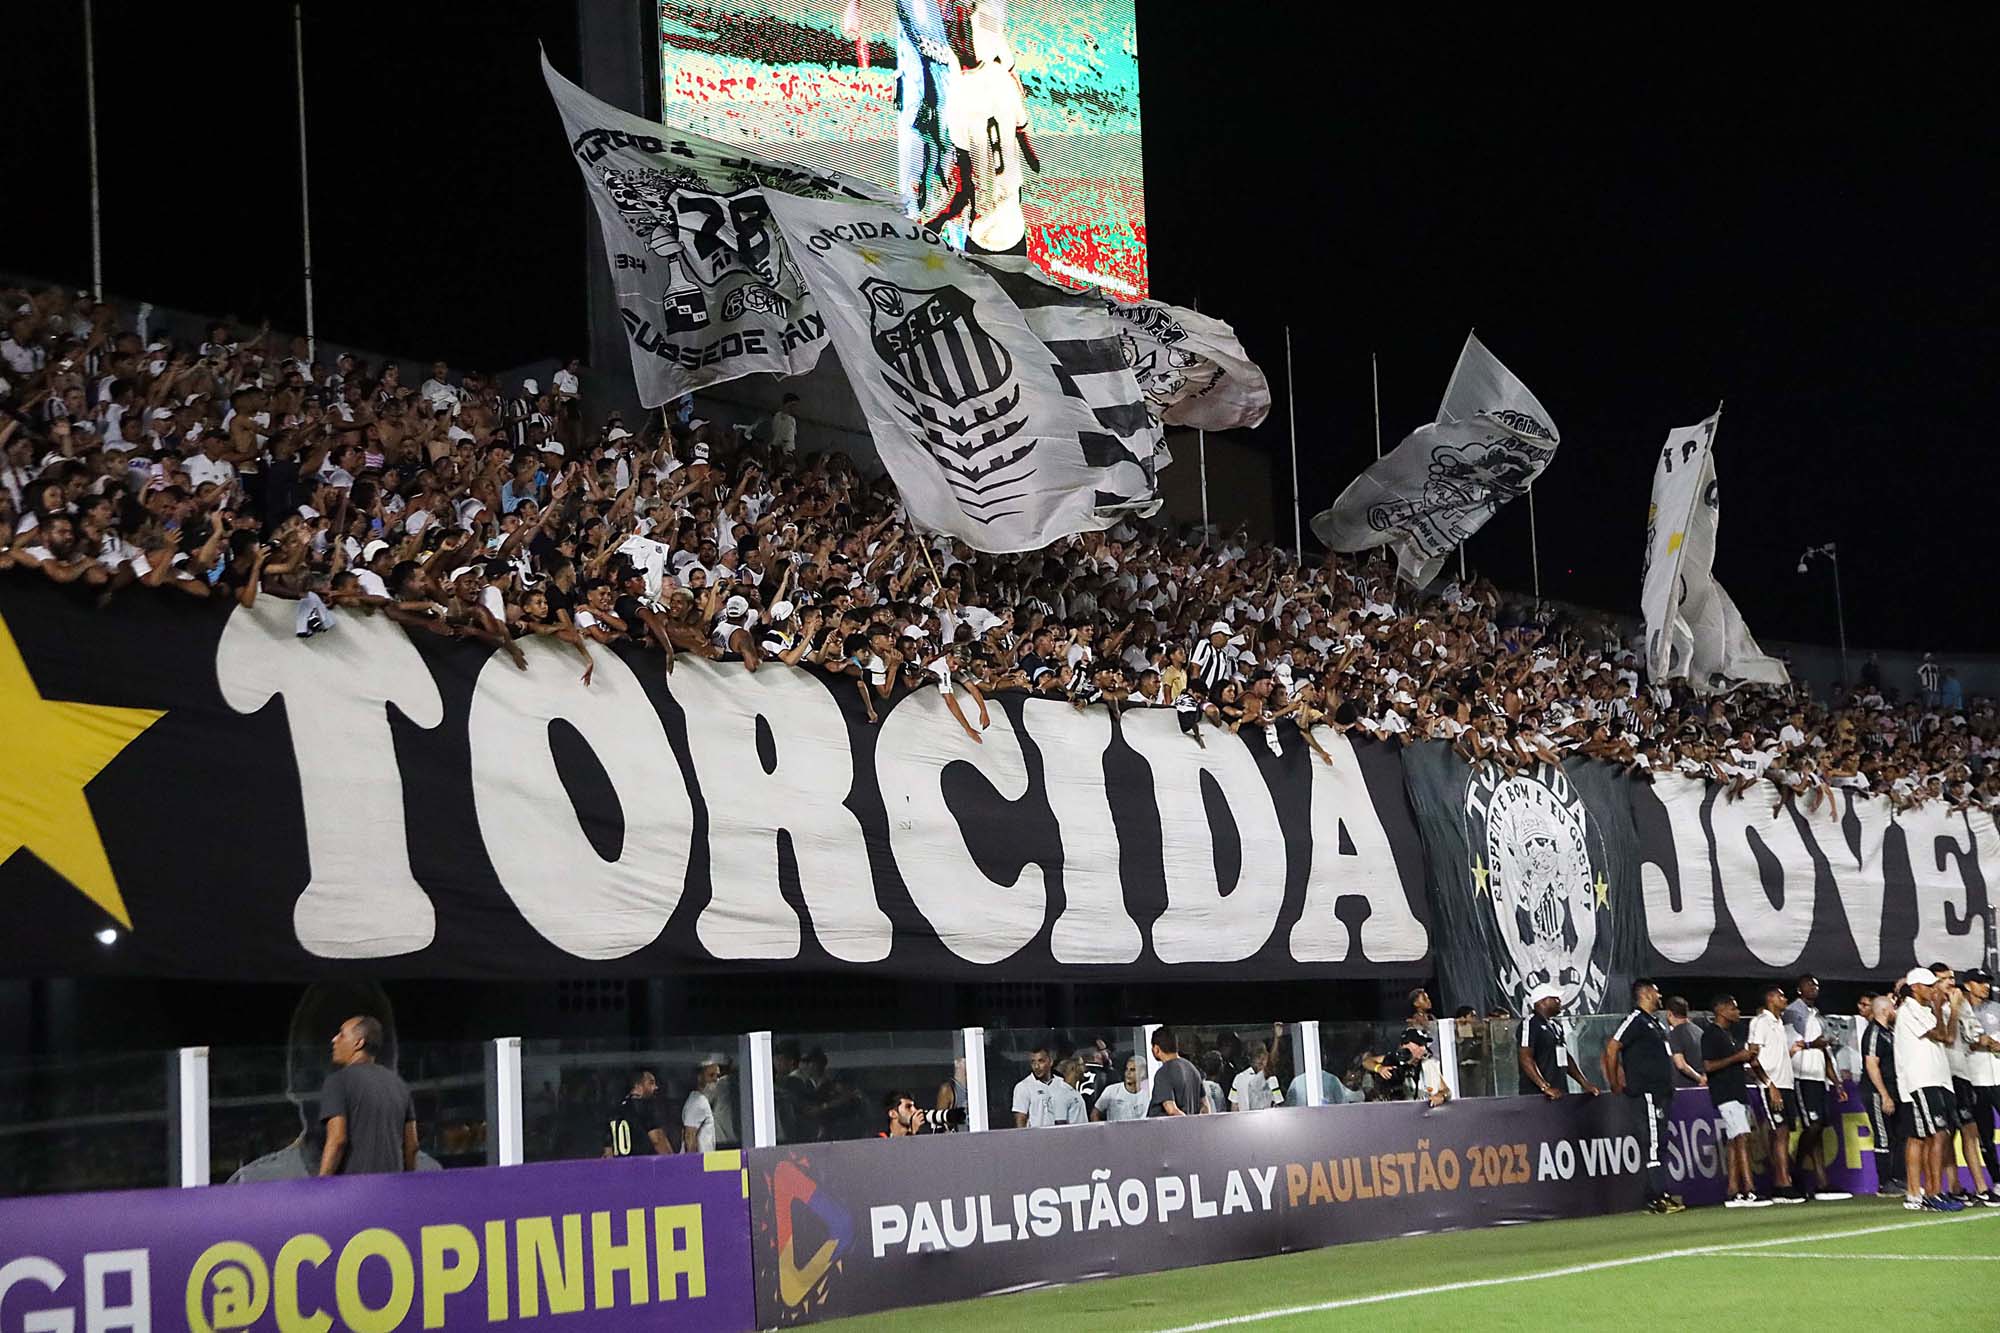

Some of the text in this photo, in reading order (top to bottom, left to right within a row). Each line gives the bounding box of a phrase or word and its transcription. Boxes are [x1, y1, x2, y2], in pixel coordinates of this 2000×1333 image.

[216, 592, 1429, 965] TORCIDA
[609, 1119, 632, 1156] 10
[1286, 1138, 1532, 1207] PAULISTÃO 2023
[1537, 1134, 1642, 1183] AO VIVO
[871, 1165, 1279, 1258] PAULISTÃO PLAY
[185, 1202, 707, 1333] @COPINHA
